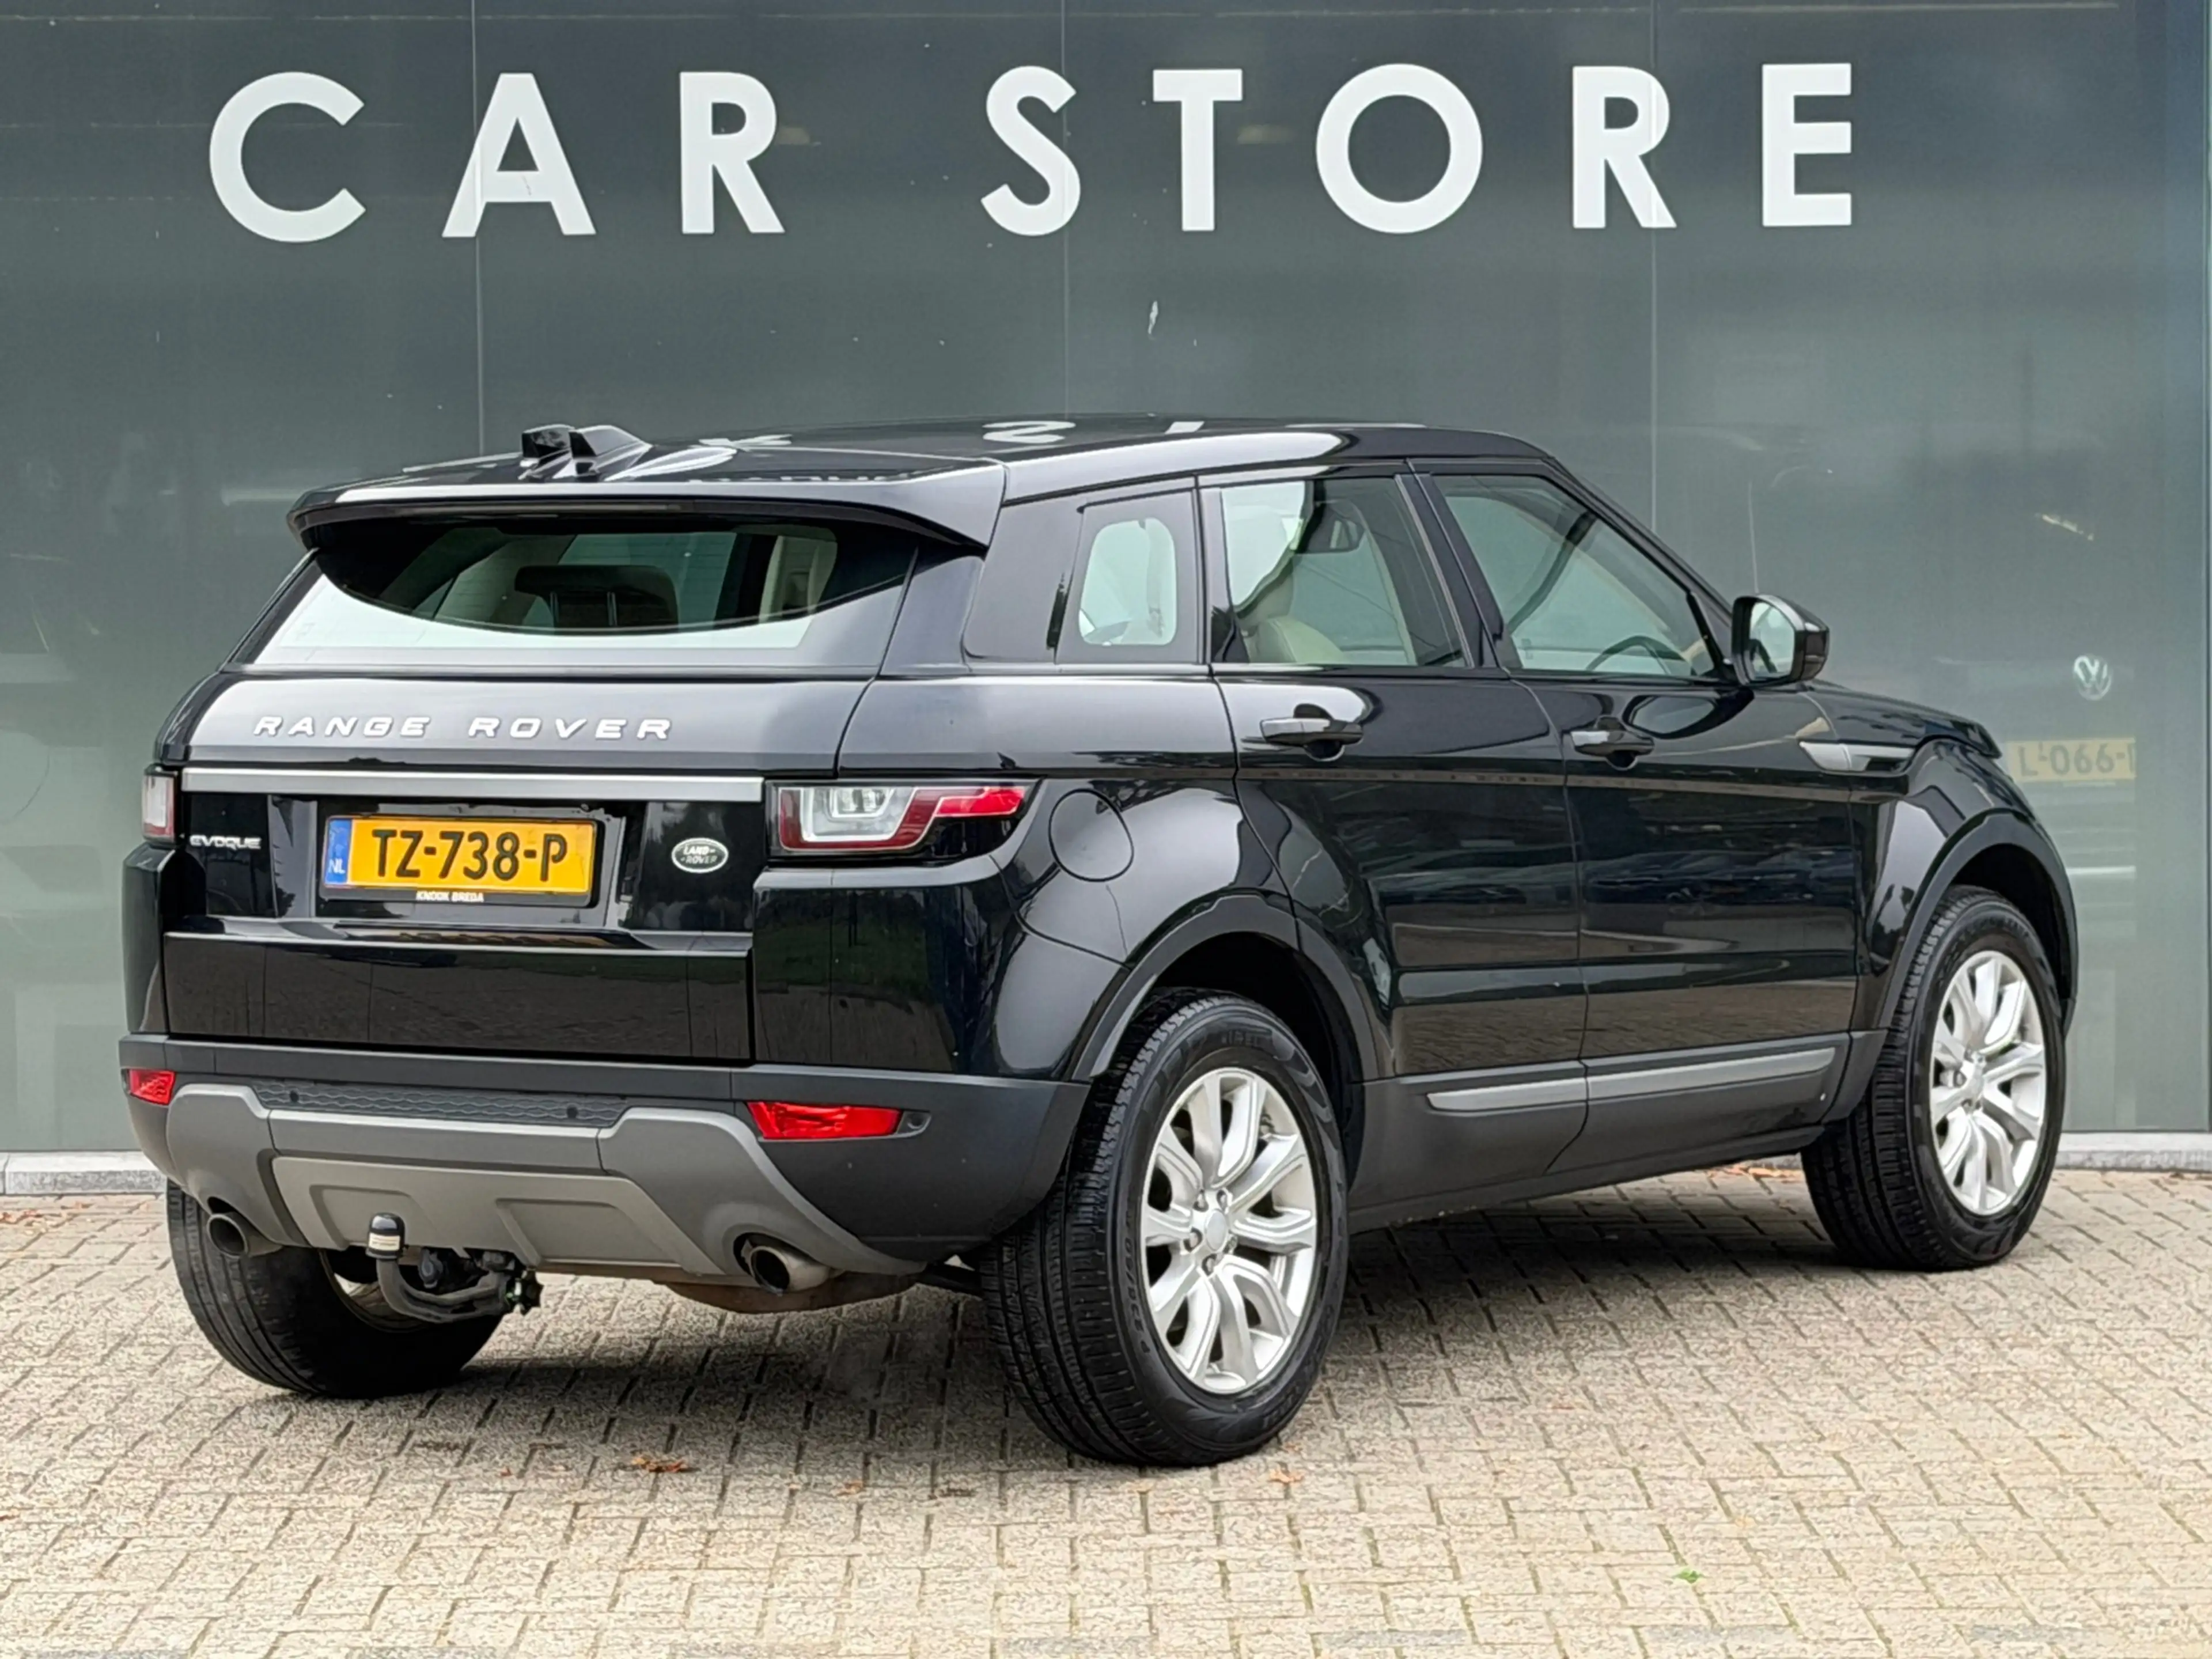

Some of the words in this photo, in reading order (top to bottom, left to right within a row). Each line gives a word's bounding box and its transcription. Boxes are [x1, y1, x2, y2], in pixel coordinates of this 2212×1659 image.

[210, 71, 785, 243] CAR
[980, 63, 1852, 236] STORE
[253, 716, 430, 737] RANGE
[468, 717, 671, 740] ROVER
[190, 835, 261, 850] EVOQUE
[328, 858, 346, 874] NL
[372, 829, 567, 882] TZ-738-P
